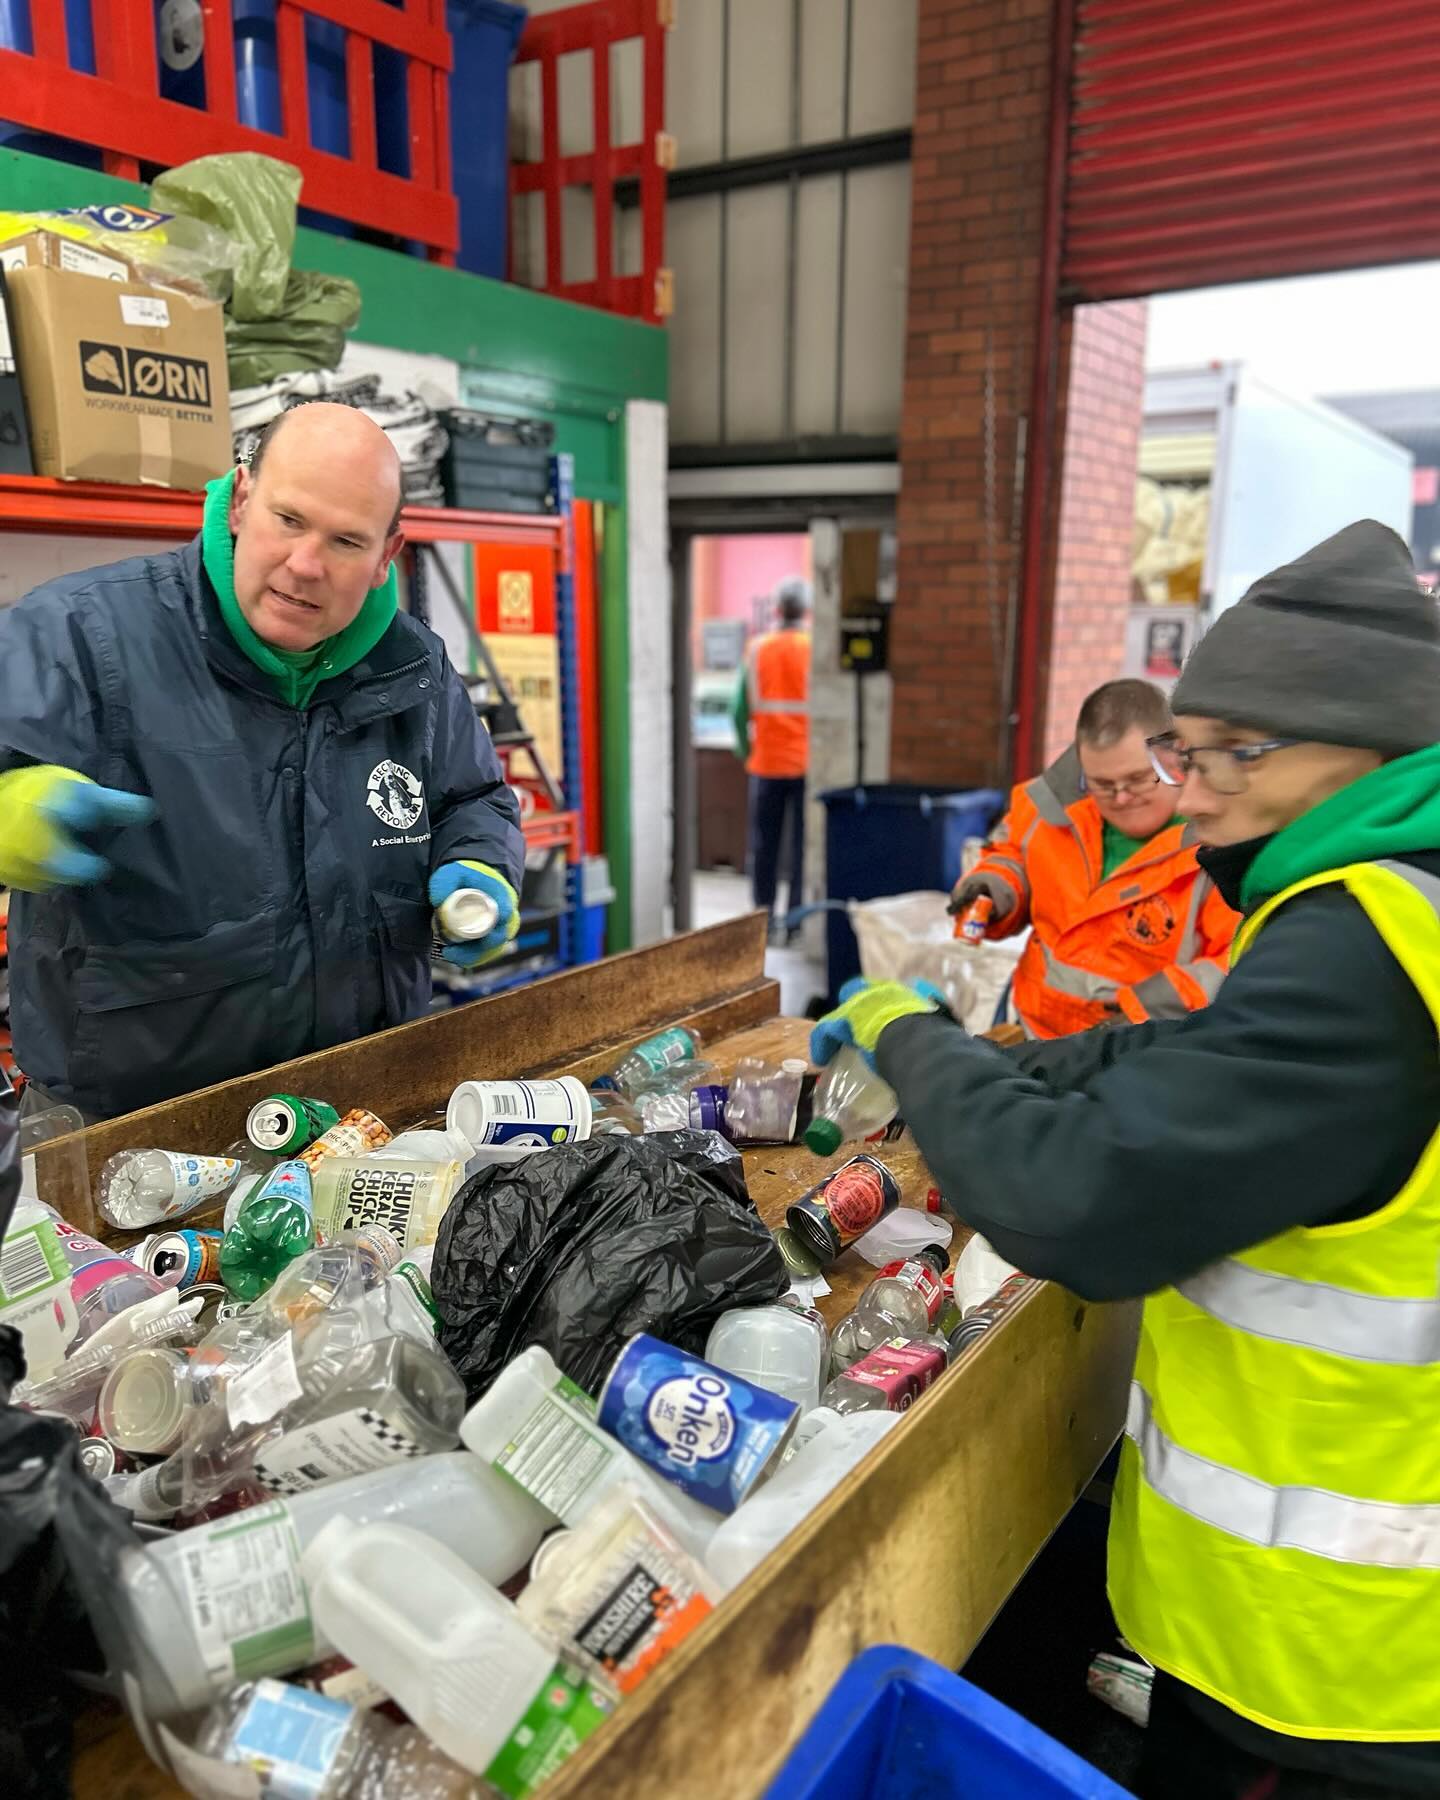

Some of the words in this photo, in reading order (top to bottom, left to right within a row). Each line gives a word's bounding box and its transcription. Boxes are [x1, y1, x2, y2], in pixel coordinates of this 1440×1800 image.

[134, 356, 208, 402] ØRN
[84, 398, 146, 415] WORKWEAR
[147, 405, 175, 419] MADE
[175, 409, 213, 423] BETTER
[372, 760, 411, 782] RECING
[371, 839, 379, 847] A
[379, 836, 404, 846] Social
[348, 1169, 370, 1215] SOUP
[374, 1171, 398, 1229] KERAL
[388, 1172, 416, 1248] CHUNKY
[671, 1376, 725, 1464] Onken
[581, 1572, 655, 1652] YORKSHIRE
